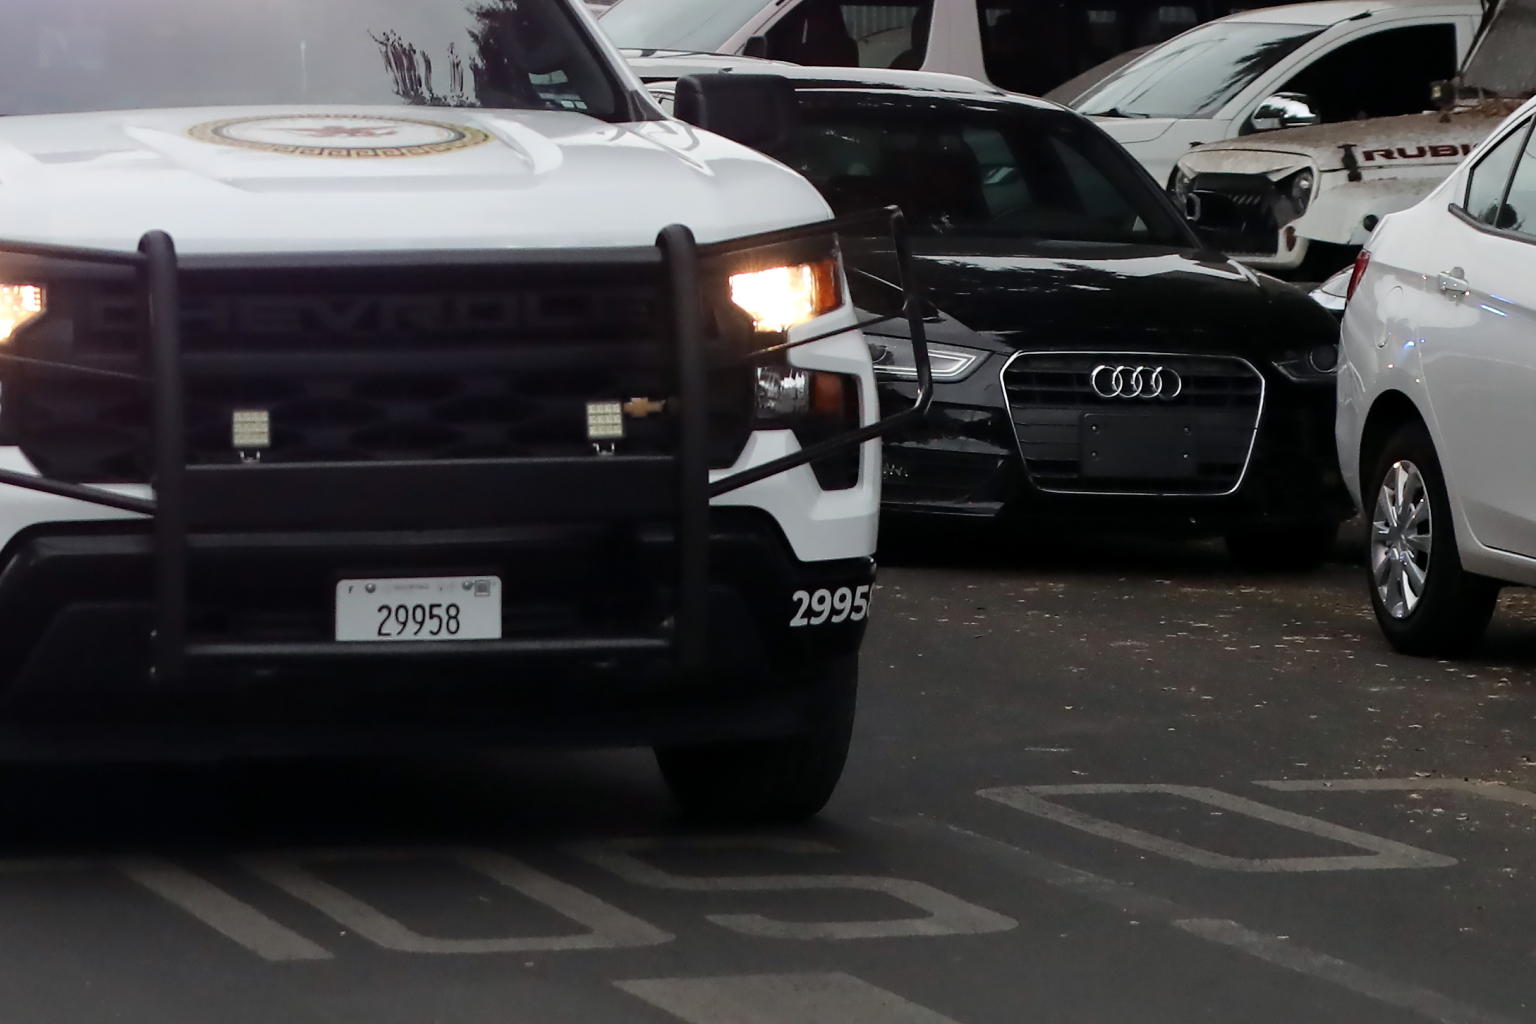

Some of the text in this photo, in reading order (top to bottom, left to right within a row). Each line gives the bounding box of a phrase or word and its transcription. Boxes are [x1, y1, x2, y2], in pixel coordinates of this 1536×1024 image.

[1362, 143, 1476, 161] RUBI
[377, 603, 460, 637] 29958
[789, 584, 874, 627] 2995
